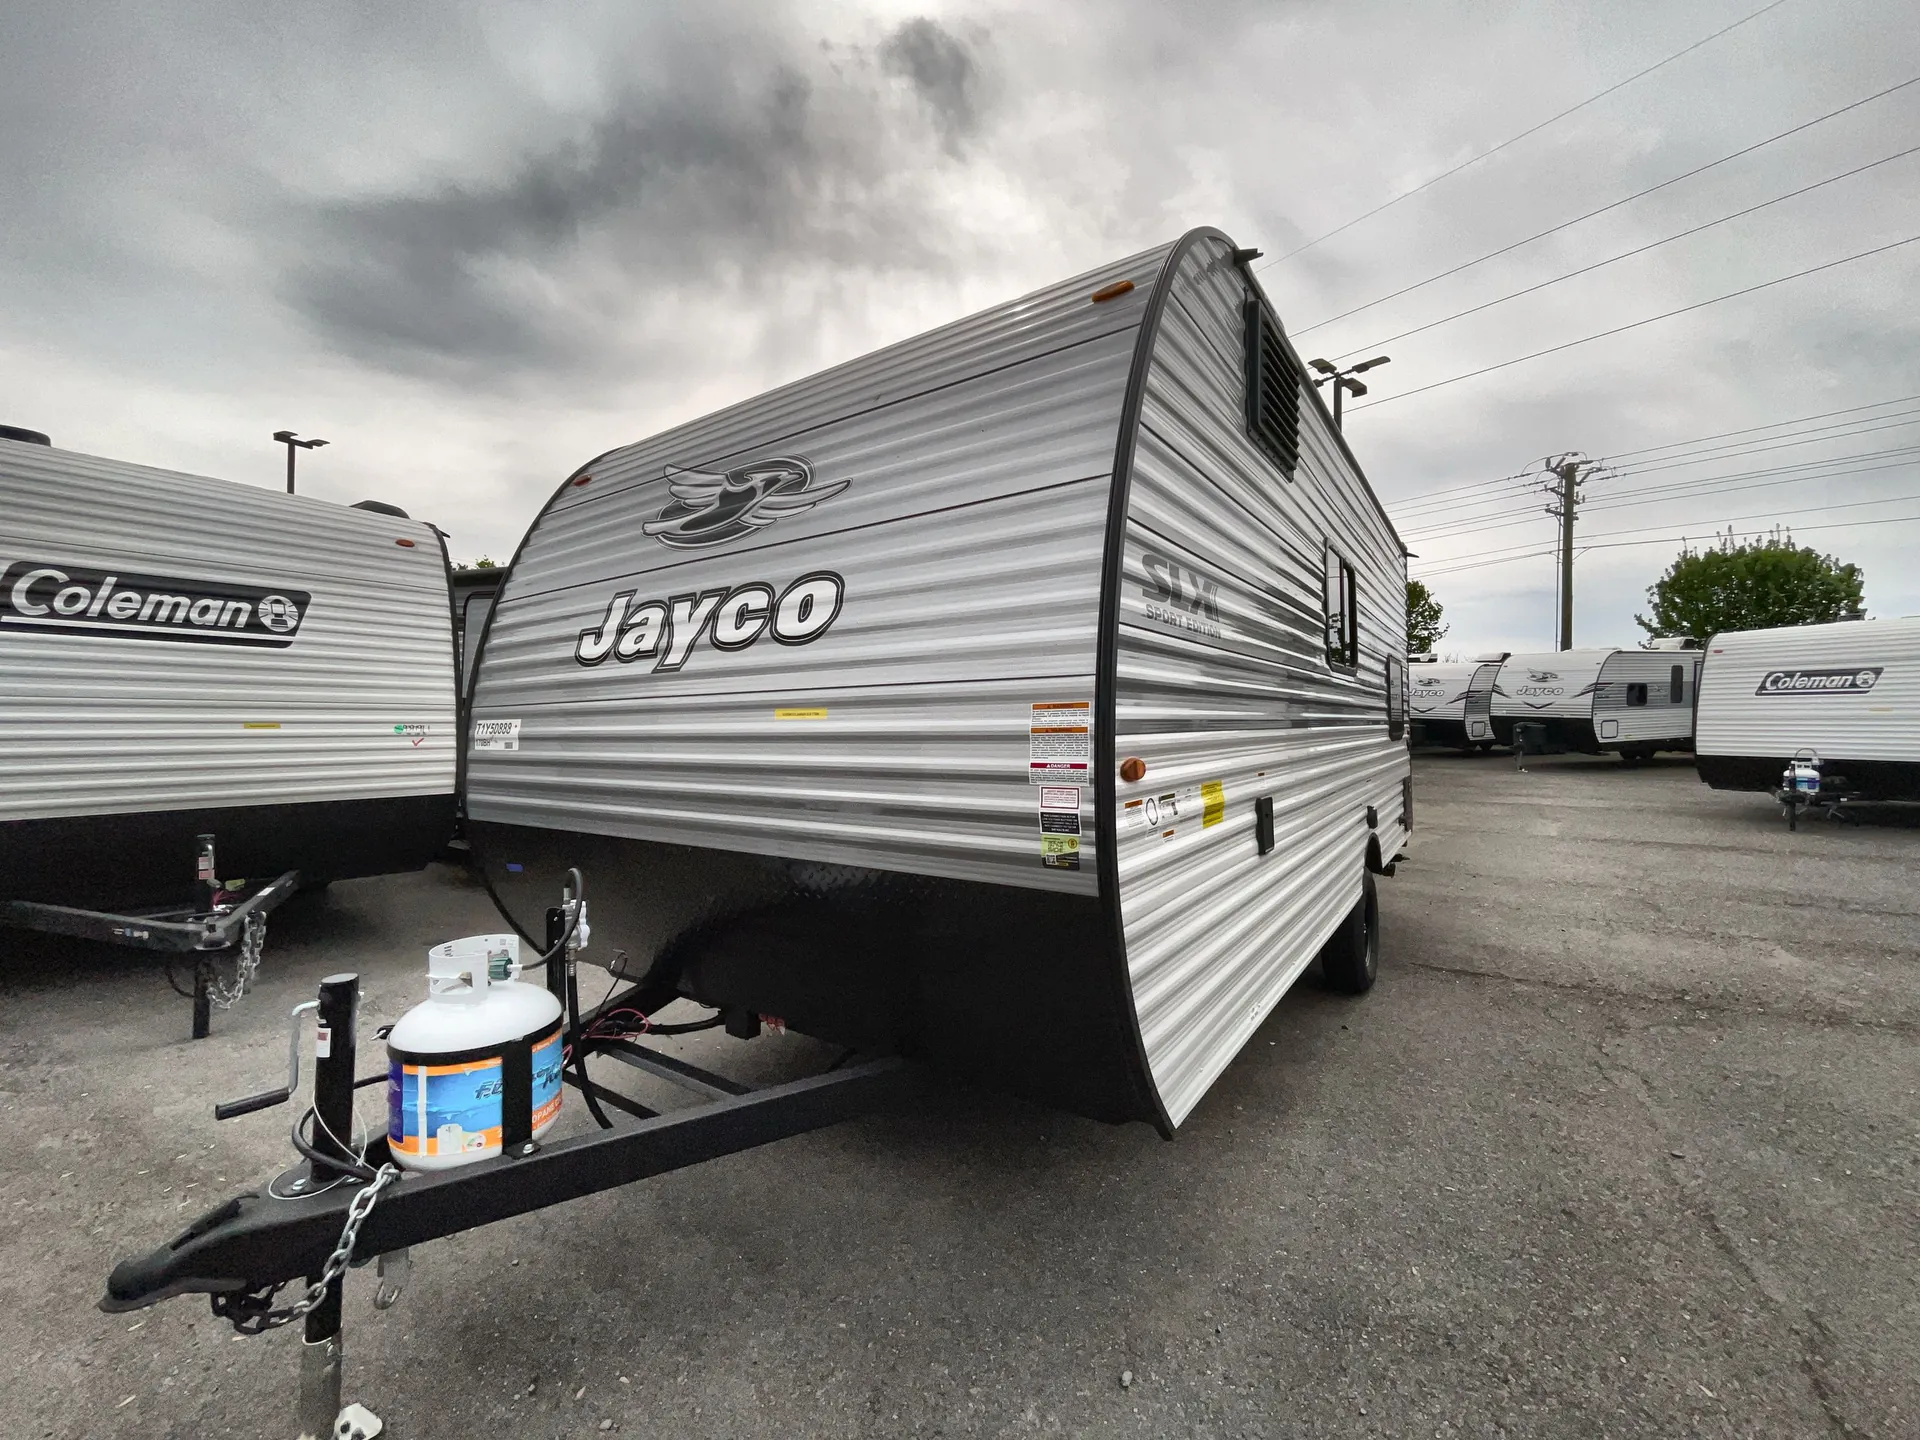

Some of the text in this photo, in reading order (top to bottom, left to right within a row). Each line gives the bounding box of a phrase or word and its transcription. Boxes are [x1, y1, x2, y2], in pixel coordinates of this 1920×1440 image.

[11, 568, 252, 629] Coleman
[1142, 554, 1219, 623] SLX
[574, 570, 846, 674] Jayco
[1145, 603, 1221, 640] SPORT EDITION
[1408, 687, 1445, 698] Jayco
[1516, 685, 1565, 697] Jayco
[1765, 671, 1854, 691] Coleman
